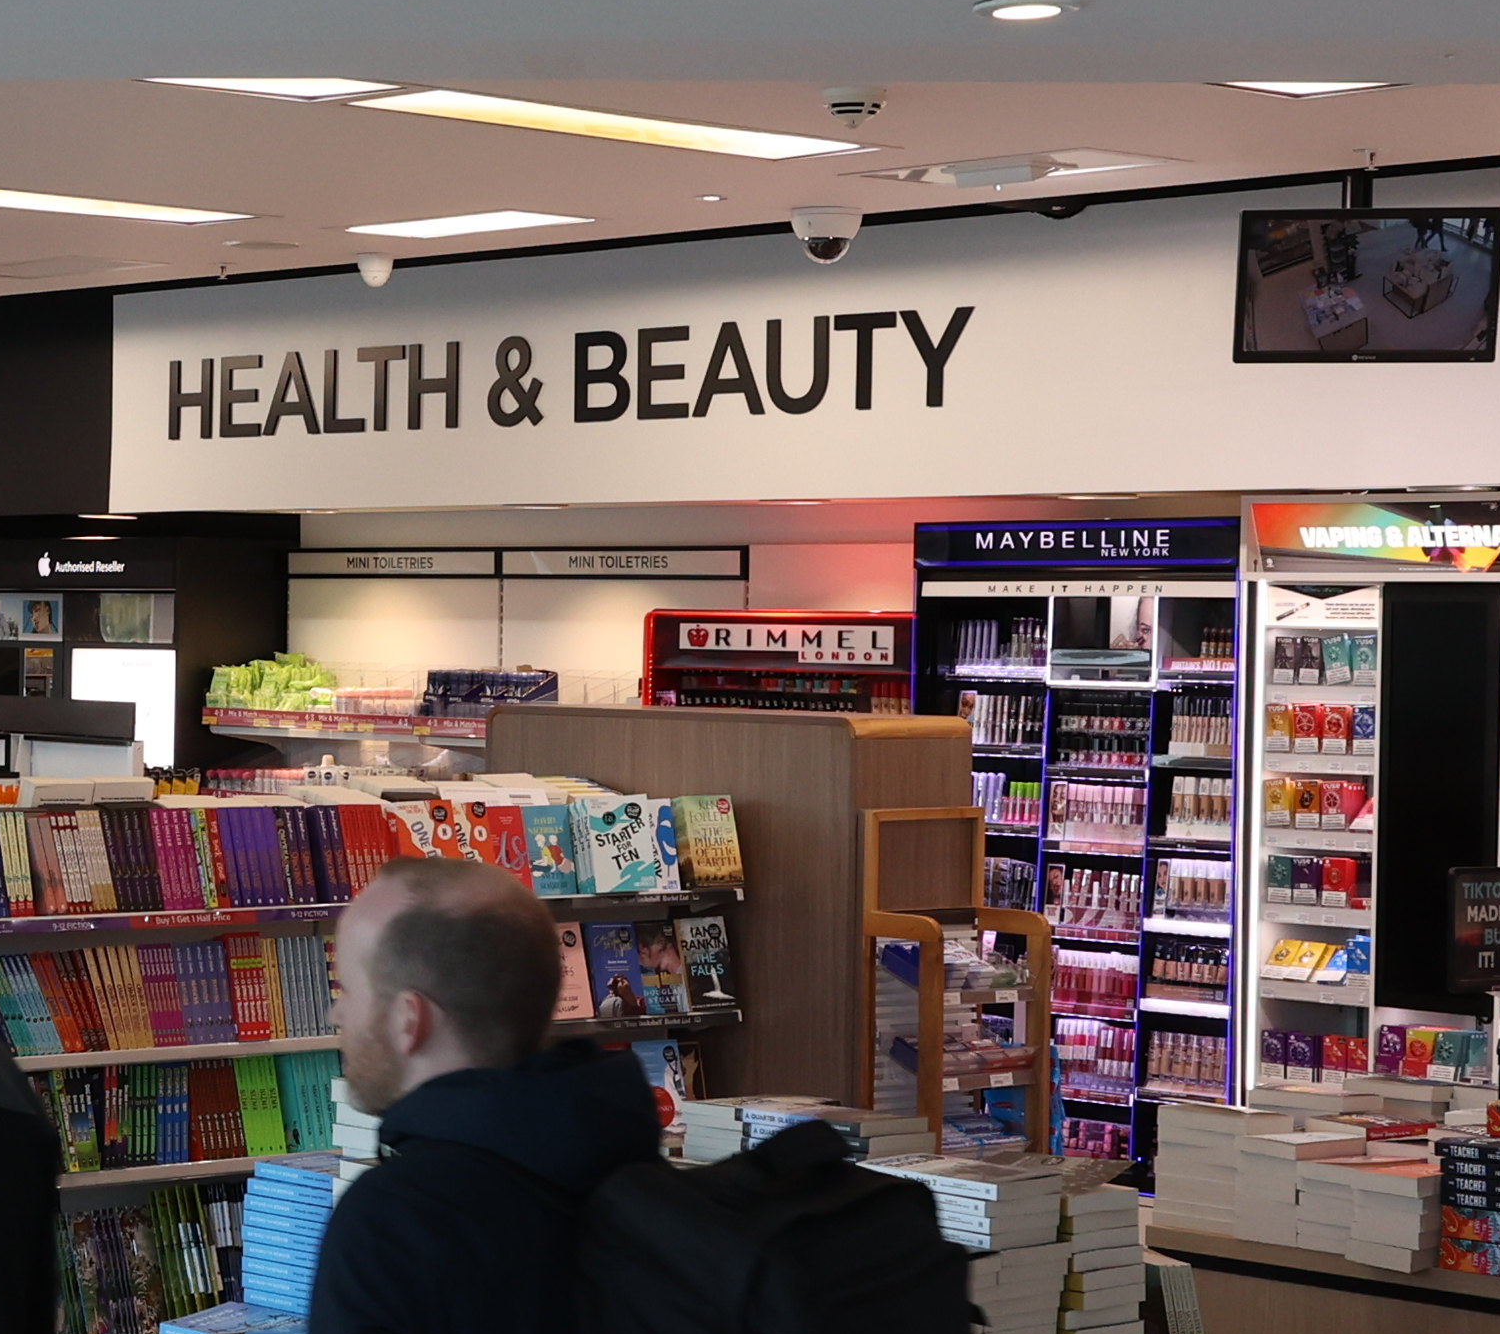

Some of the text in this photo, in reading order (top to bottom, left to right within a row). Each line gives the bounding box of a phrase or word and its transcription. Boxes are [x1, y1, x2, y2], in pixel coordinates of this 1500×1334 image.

[168, 306, 976, 440] HEALTH & BEAUTY
[975, 529, 1171, 550] MAYBELLINE
[1299, 526, 1382, 549] VAPING
[1387, 527, 1405, 547] &
[1101, 548, 1170, 558] NEW YORK
[54, 558, 125, 574] Authorised Reseller
[346, 557, 434, 569] MINI TOILETRIES
[987, 584, 1165, 594] MAKE IT HAPPEN
[713, 629, 890, 651] RIMMEL
[800, 651, 890, 662] LONDON
[595, 817, 646, 848] STARTER
[616, 841, 632, 853] FOR
[612, 850, 640, 870] TEN
[67, 921, 93, 930] FICTION
[682, 938, 727, 950] RANKIN
[696, 954, 717, 964] THE
[1478, 951, 1495, 968] IT!
[691, 964, 724, 976] FALLS
[1450, 1145, 1480, 1159] TEACHER
